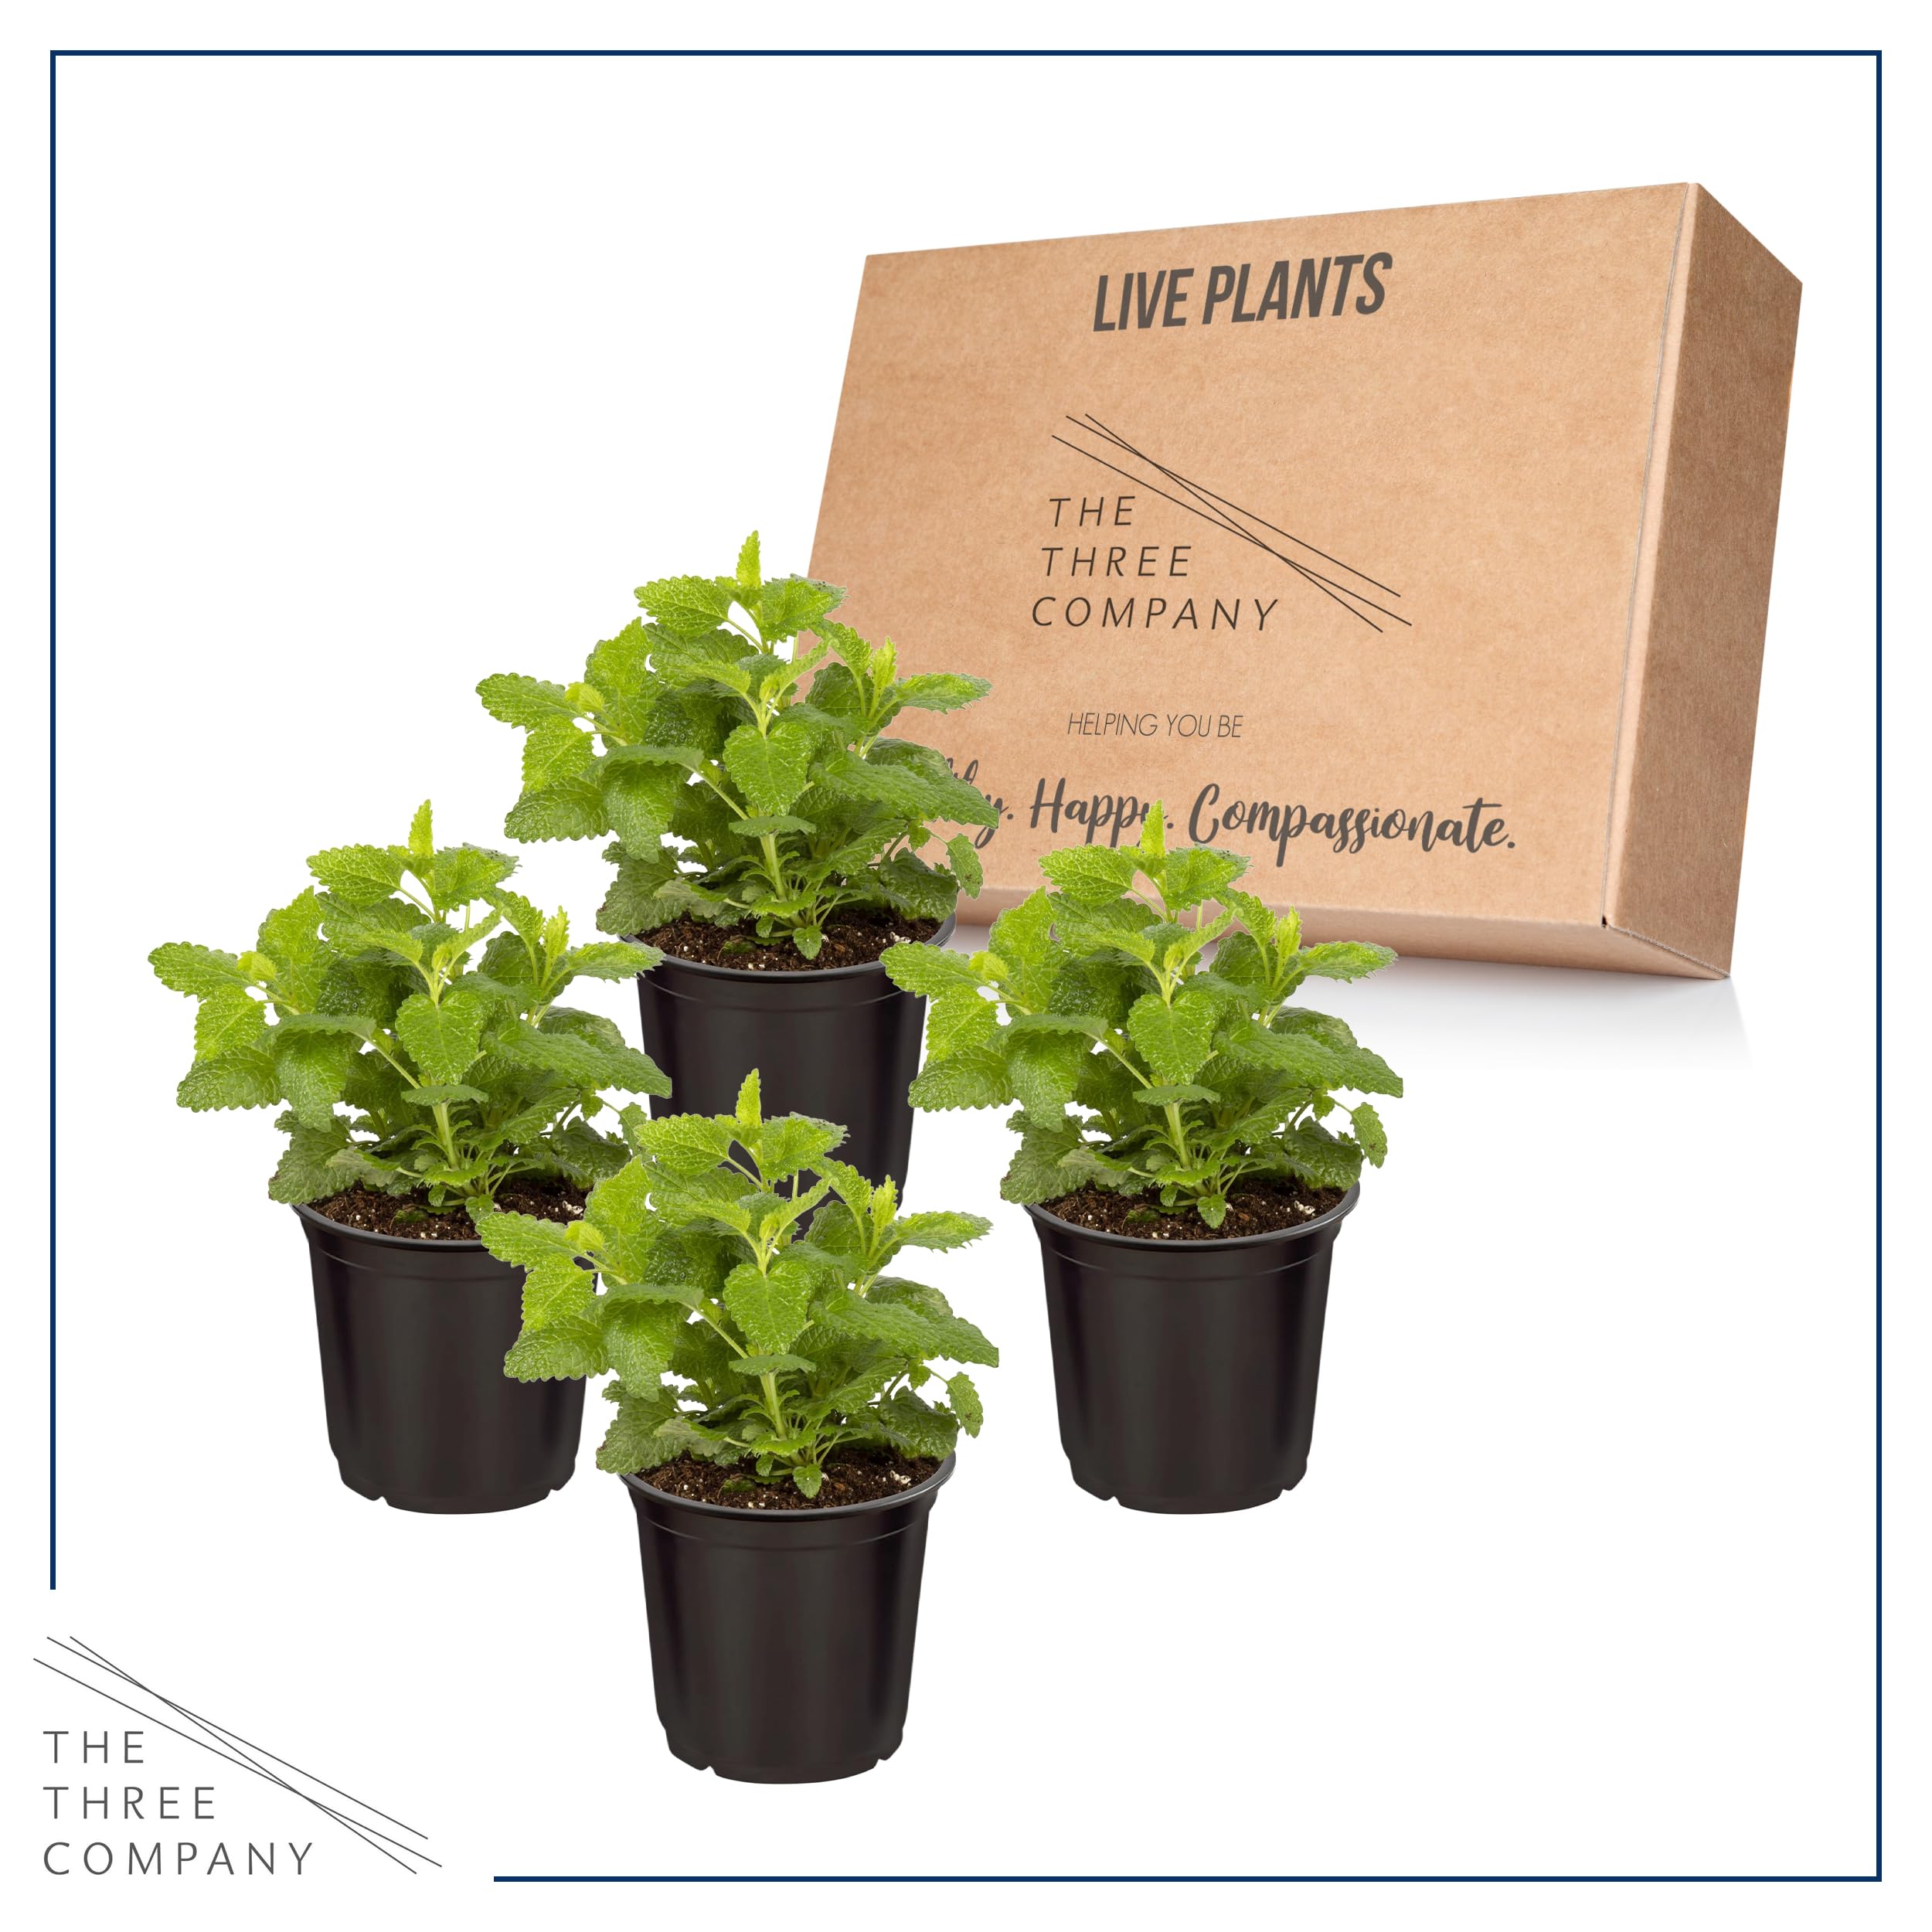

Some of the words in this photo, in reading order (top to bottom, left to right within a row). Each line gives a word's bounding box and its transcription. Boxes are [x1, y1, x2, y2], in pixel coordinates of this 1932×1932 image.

[1093, 267, 1195, 332] LIVE
[1202, 252, 1393, 325] PLANTS
[1049, 495, 1136, 528] THE
[1041, 546, 1192, 577] THREE
[1032, 596, 1278, 631] COMPANY
[1067, 713, 1158, 736] HELPING
[1167, 714, 1213, 737] YOU
[1218, 715, 1243, 738] BE
[1188, 783, 1515, 868] Compassionate.
